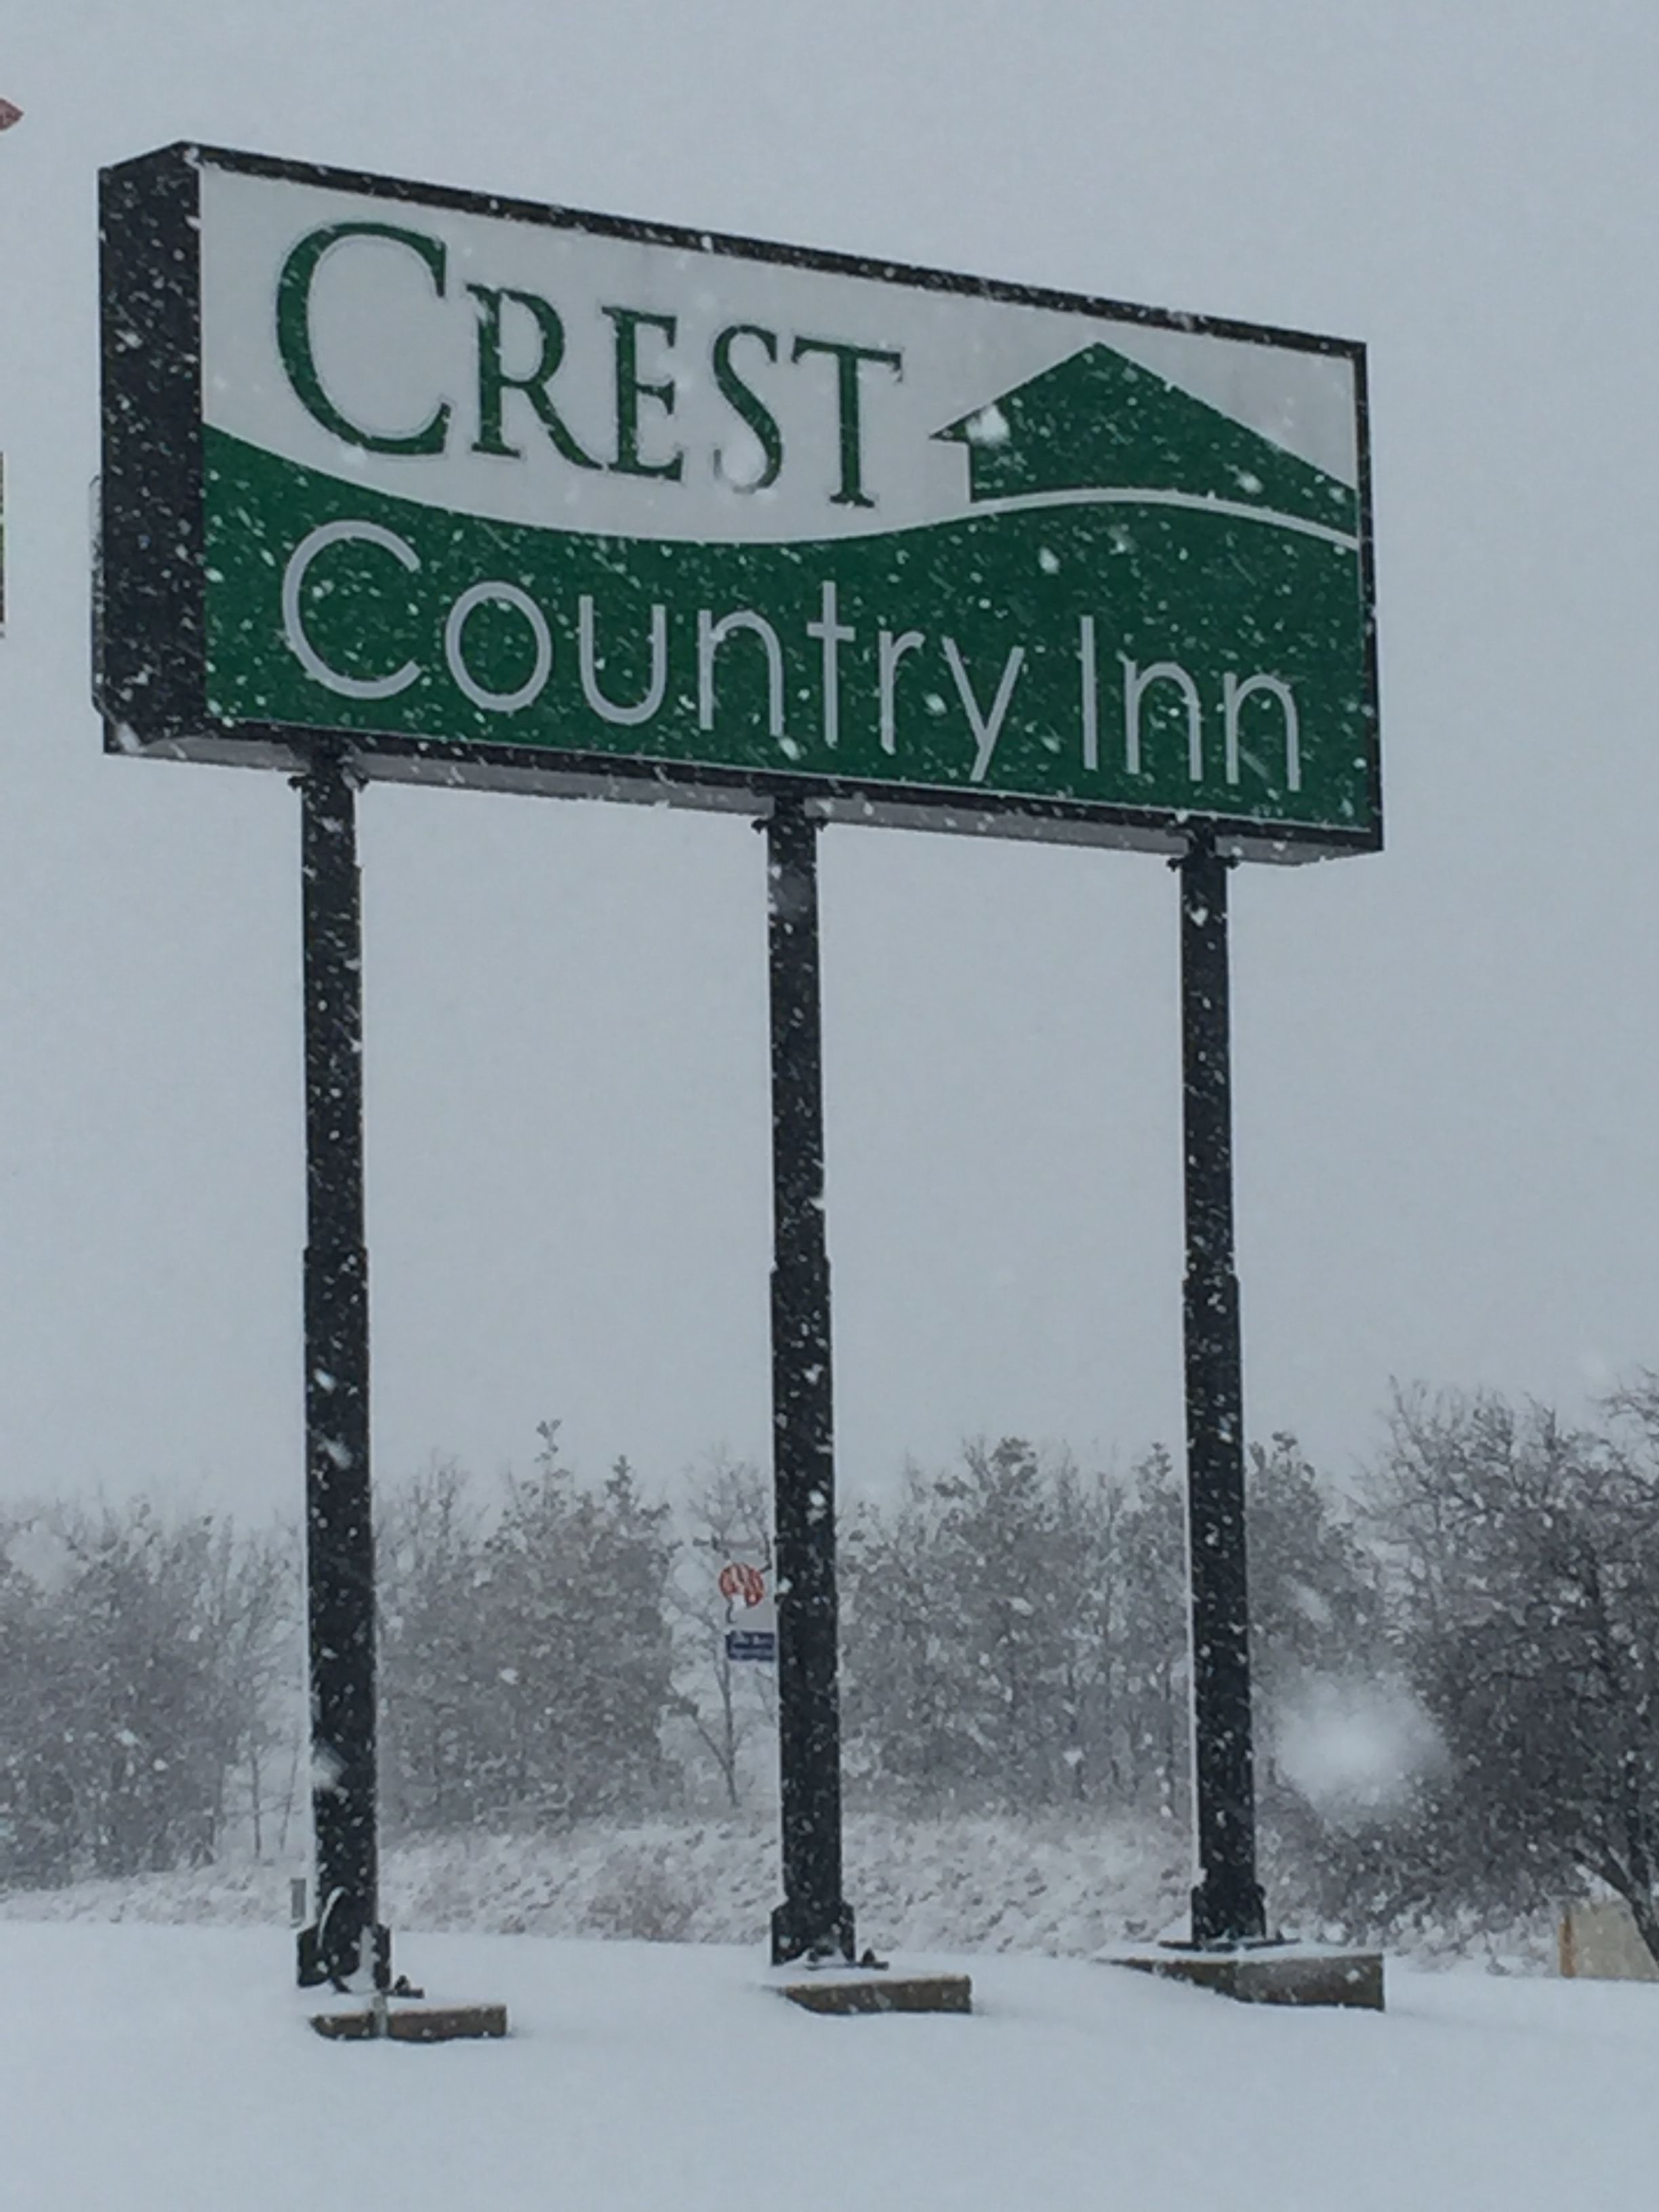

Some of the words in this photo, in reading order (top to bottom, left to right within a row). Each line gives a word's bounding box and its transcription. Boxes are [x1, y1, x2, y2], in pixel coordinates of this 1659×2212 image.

[276, 222, 903, 509] CREST
[281, 519, 1025, 782] Country
[1080, 615, 1300, 792] Inn
